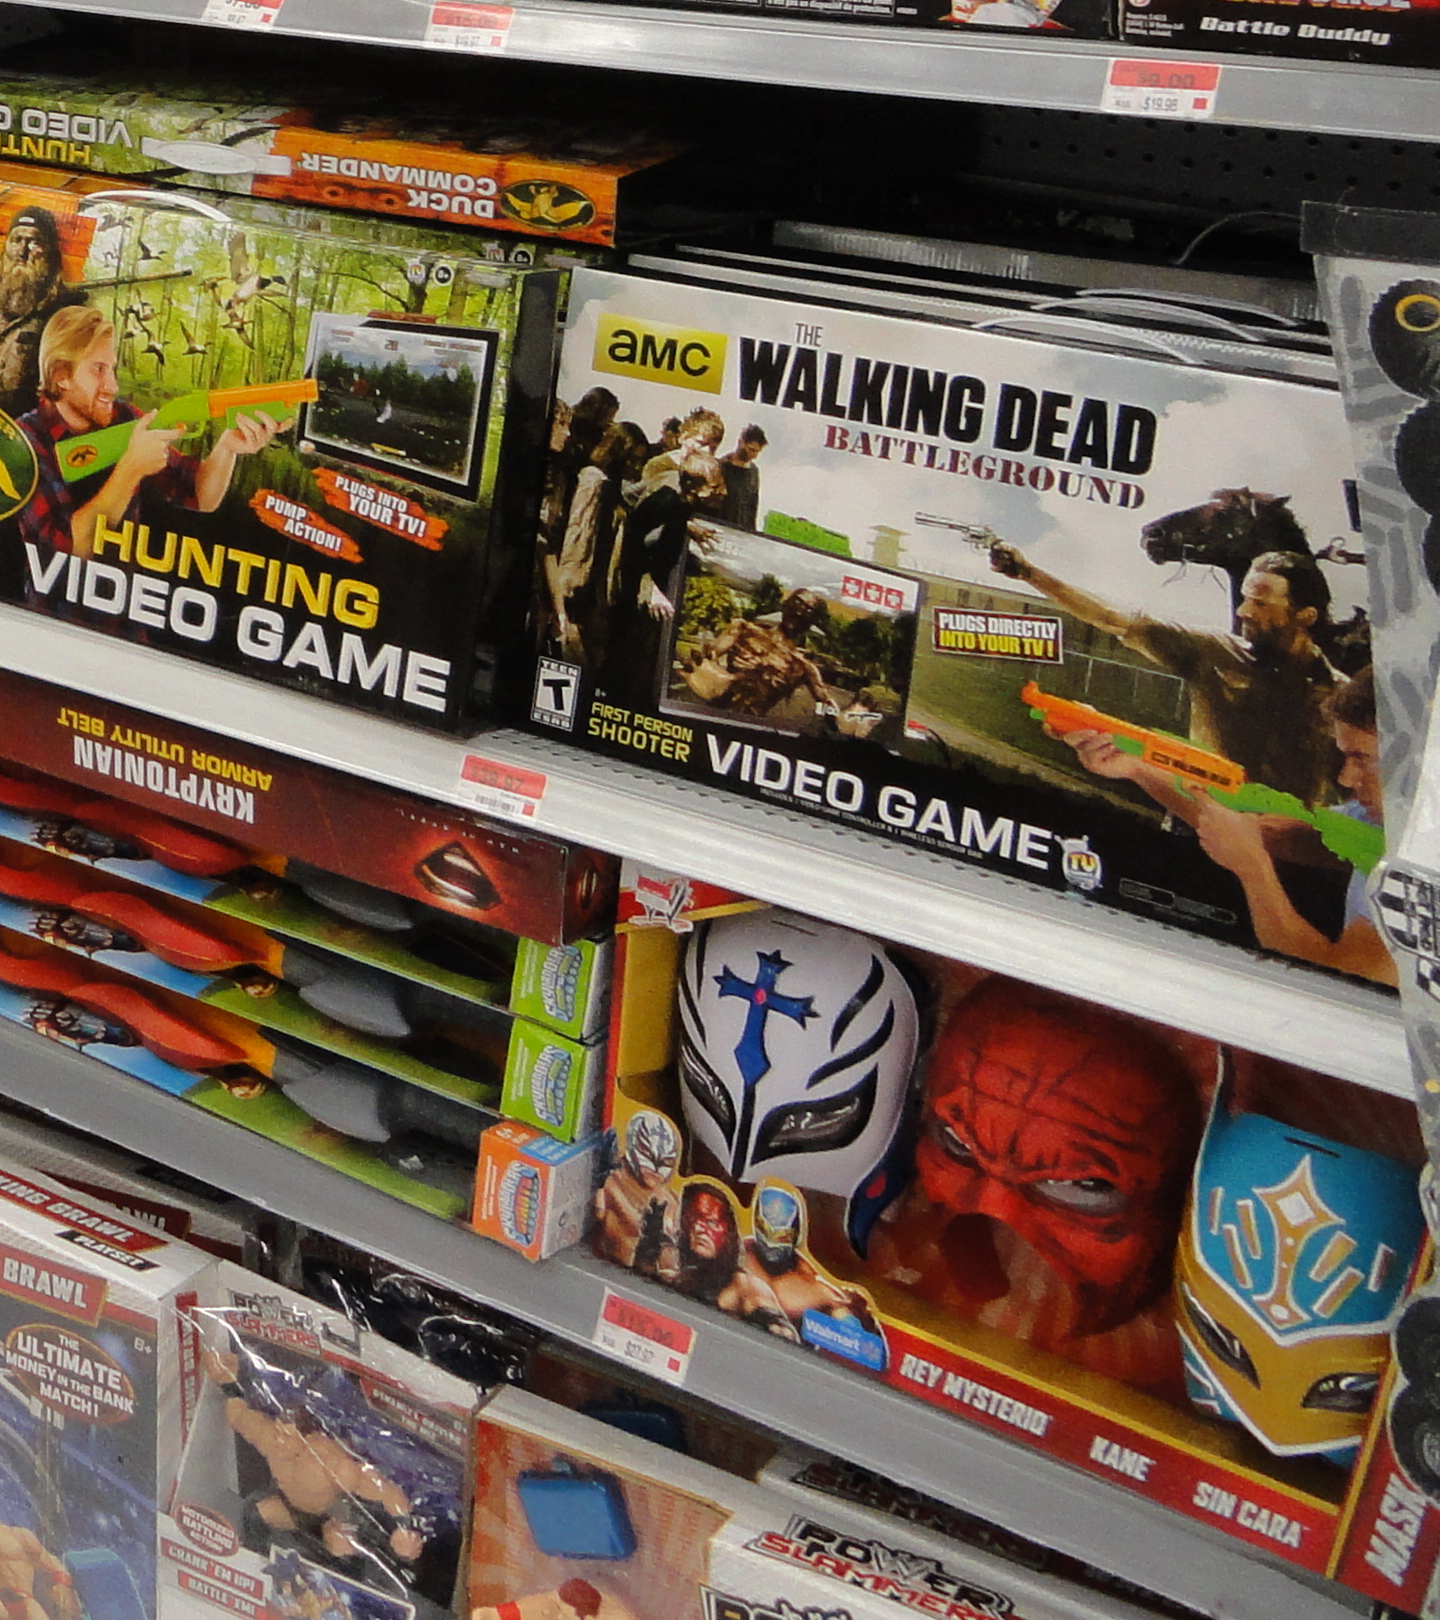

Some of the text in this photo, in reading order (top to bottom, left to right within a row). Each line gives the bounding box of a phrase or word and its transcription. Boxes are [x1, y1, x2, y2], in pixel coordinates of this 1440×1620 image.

[1200, 16, 1290, 38] Battle
[1297, 23, 1391, 47] Buddy
[20, 107, 132, 148] VIDEO
[305, 152, 498, 198] COMMANDER
[407, 191, 495, 218] DUCK
[795, 321, 823, 348] THE
[739, 336, 1157, 477] WALKING DEAD
[823, 423, 1146, 511] BATTLEGROUND
[266, 493, 306, 523] PUMP
[335, 474, 408, 512] PLUGS INTO
[284, 517, 342, 552] ACTION!
[349, 493, 426, 538] YOUR TV!
[93, 514, 380, 630] HUNTING
[25, 542, 451, 714] VIDEO GAME
[938, 609, 1058, 641] PLUGS DIRECTLY
[939, 628, 1055, 661] INTO YOUR TV!
[540, 658, 576, 677] TEEN
[542, 675, 570, 712] T
[532, 712, 572, 730] ESRB
[587, 718, 691, 765] SHOOTER
[590, 700, 693, 744] FIRST PERSON
[57, 707, 273, 791] ARMOR UTILITY BELT
[73, 735, 254, 823] KRYPTONIAN
[704, 732, 863, 815] VIDEO
[877, 784, 1055, 871] GAME
[46, 1200, 136, 1243] BRAWL
[74, 1234, 151, 1269] PLAYSET
[2, 1255, 87, 1310] BRAWL
[58, 1333, 80, 1352] THE
[134, 1336, 153, 1355] 8+
[804, 1316, 862, 1356] Walmart
[5, 1349, 134, 1416] MONEY THE BANK
[17, 1331, 122, 1391] ULTIMATE
[38, 1383, 100, 1419] MATCH!
[899, 1352, 1048, 1438] REY MYSTERIO
[1090, 1435, 1152, 1482] KANE
[1192, 1481, 1304, 1549] SIN CARA
